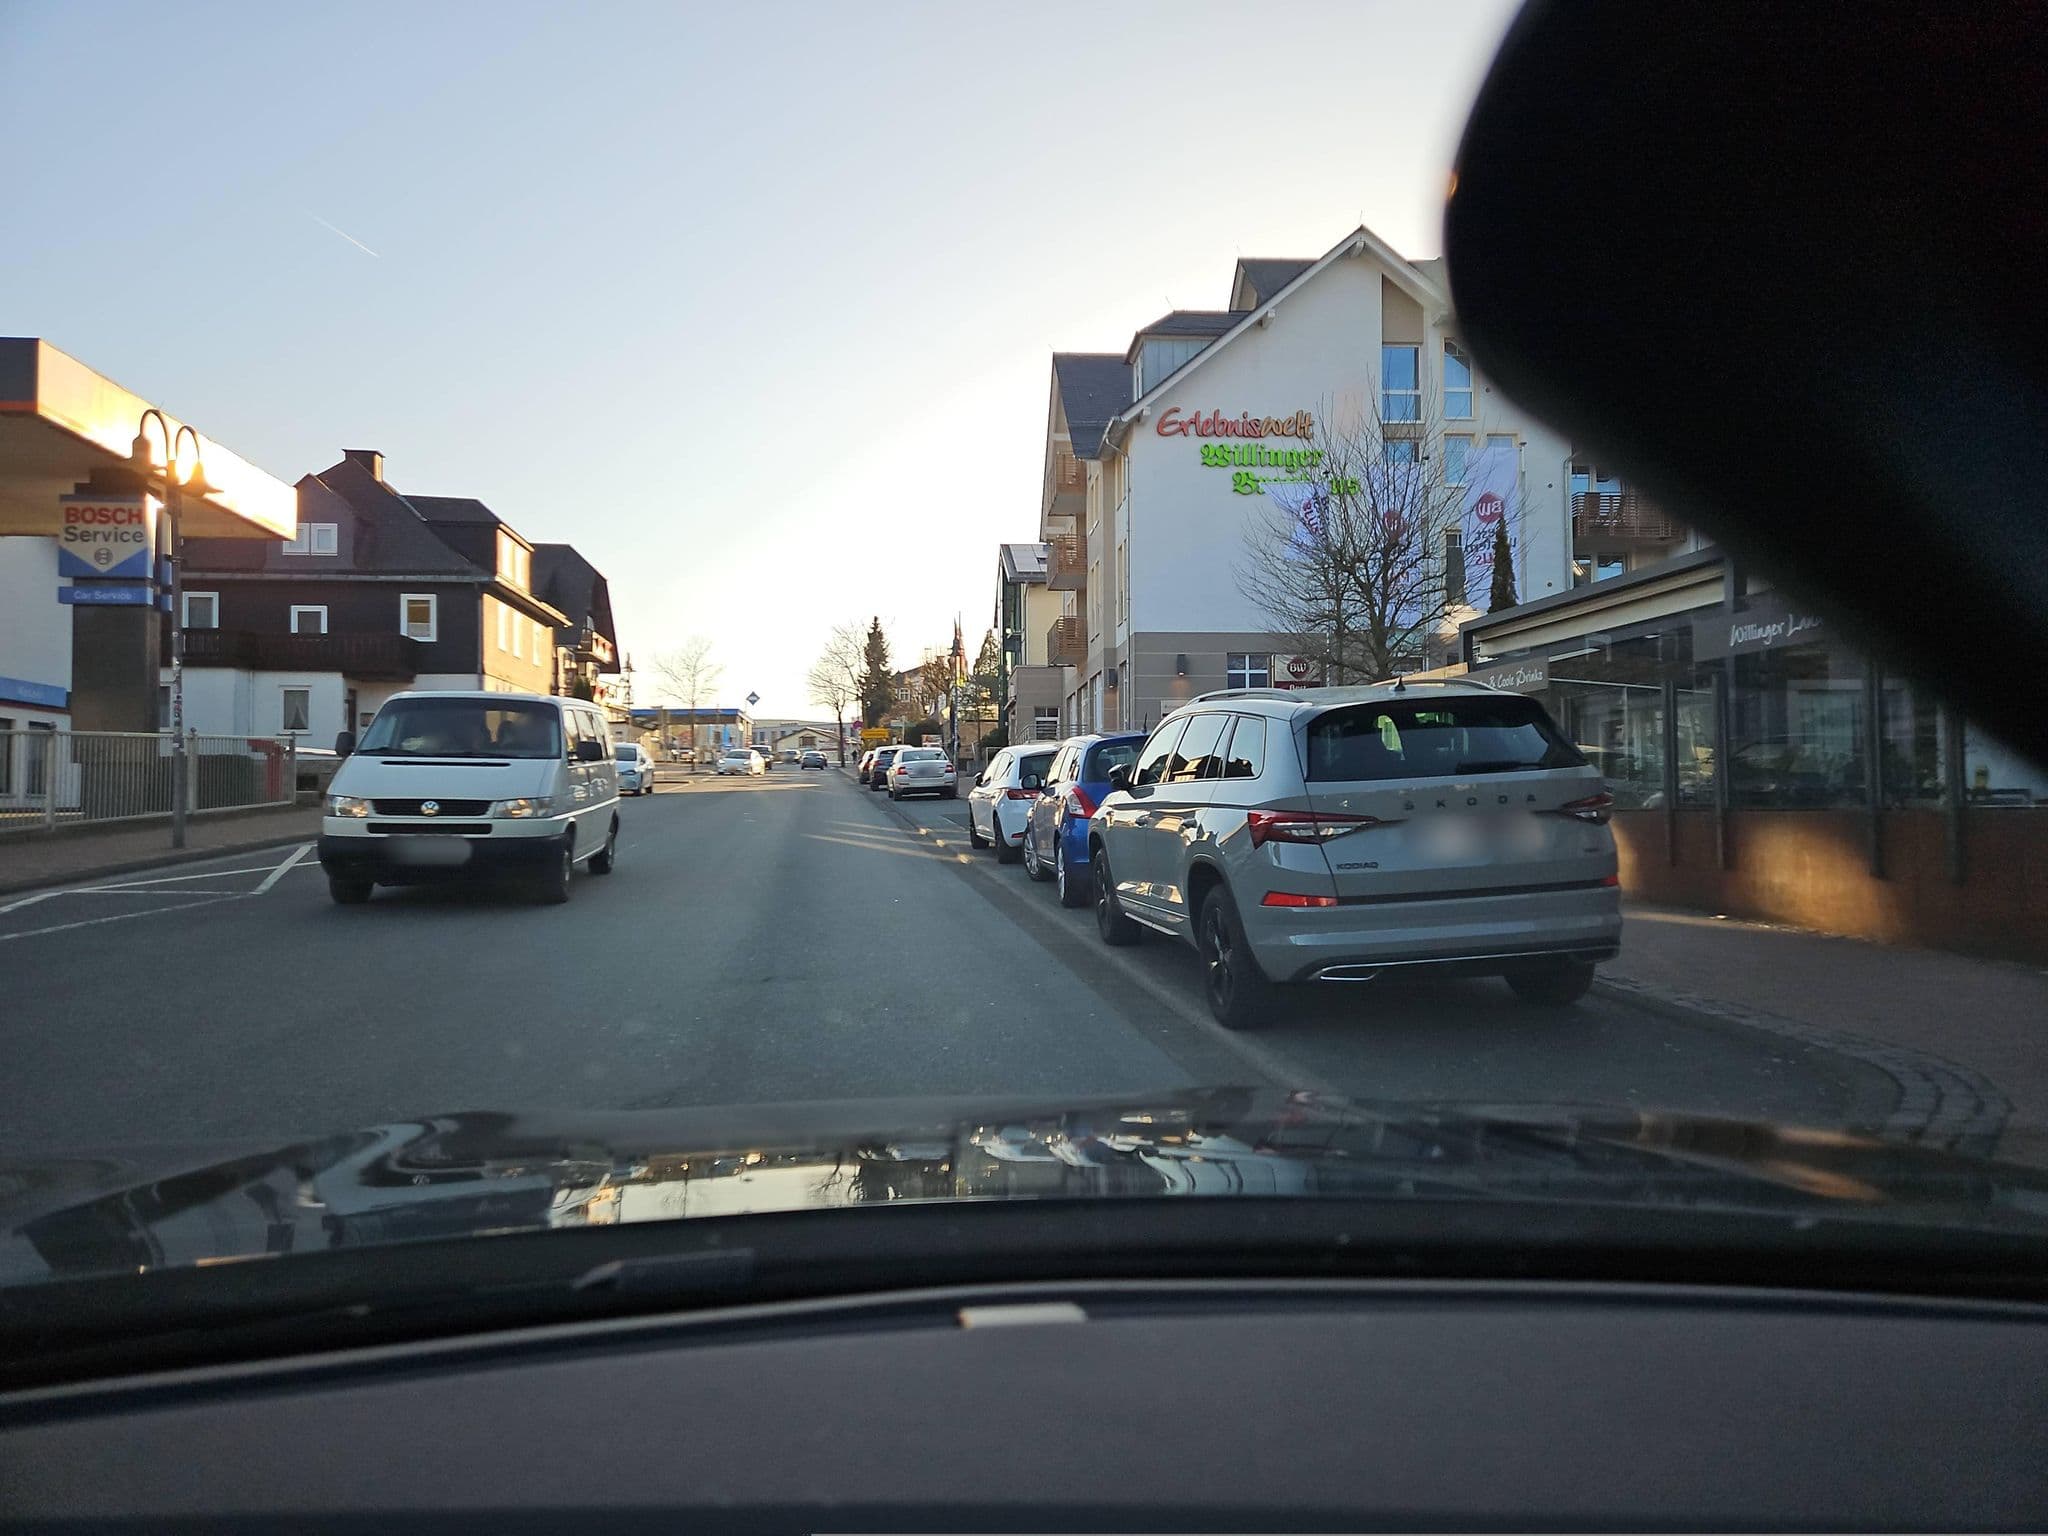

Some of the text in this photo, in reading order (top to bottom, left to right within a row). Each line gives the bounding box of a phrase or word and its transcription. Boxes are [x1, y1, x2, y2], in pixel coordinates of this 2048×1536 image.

[1157, 407, 1314, 439] Erlebniswelt
[1200, 443, 1322, 473] Willinger
[64, 506, 143, 524] BOSCH
[63, 526, 144, 542] Service
[1730, 622, 1784, 647] Willinger
[1290, 663, 1307, 673] BW
[1515, 667, 1543, 687] Drinks
